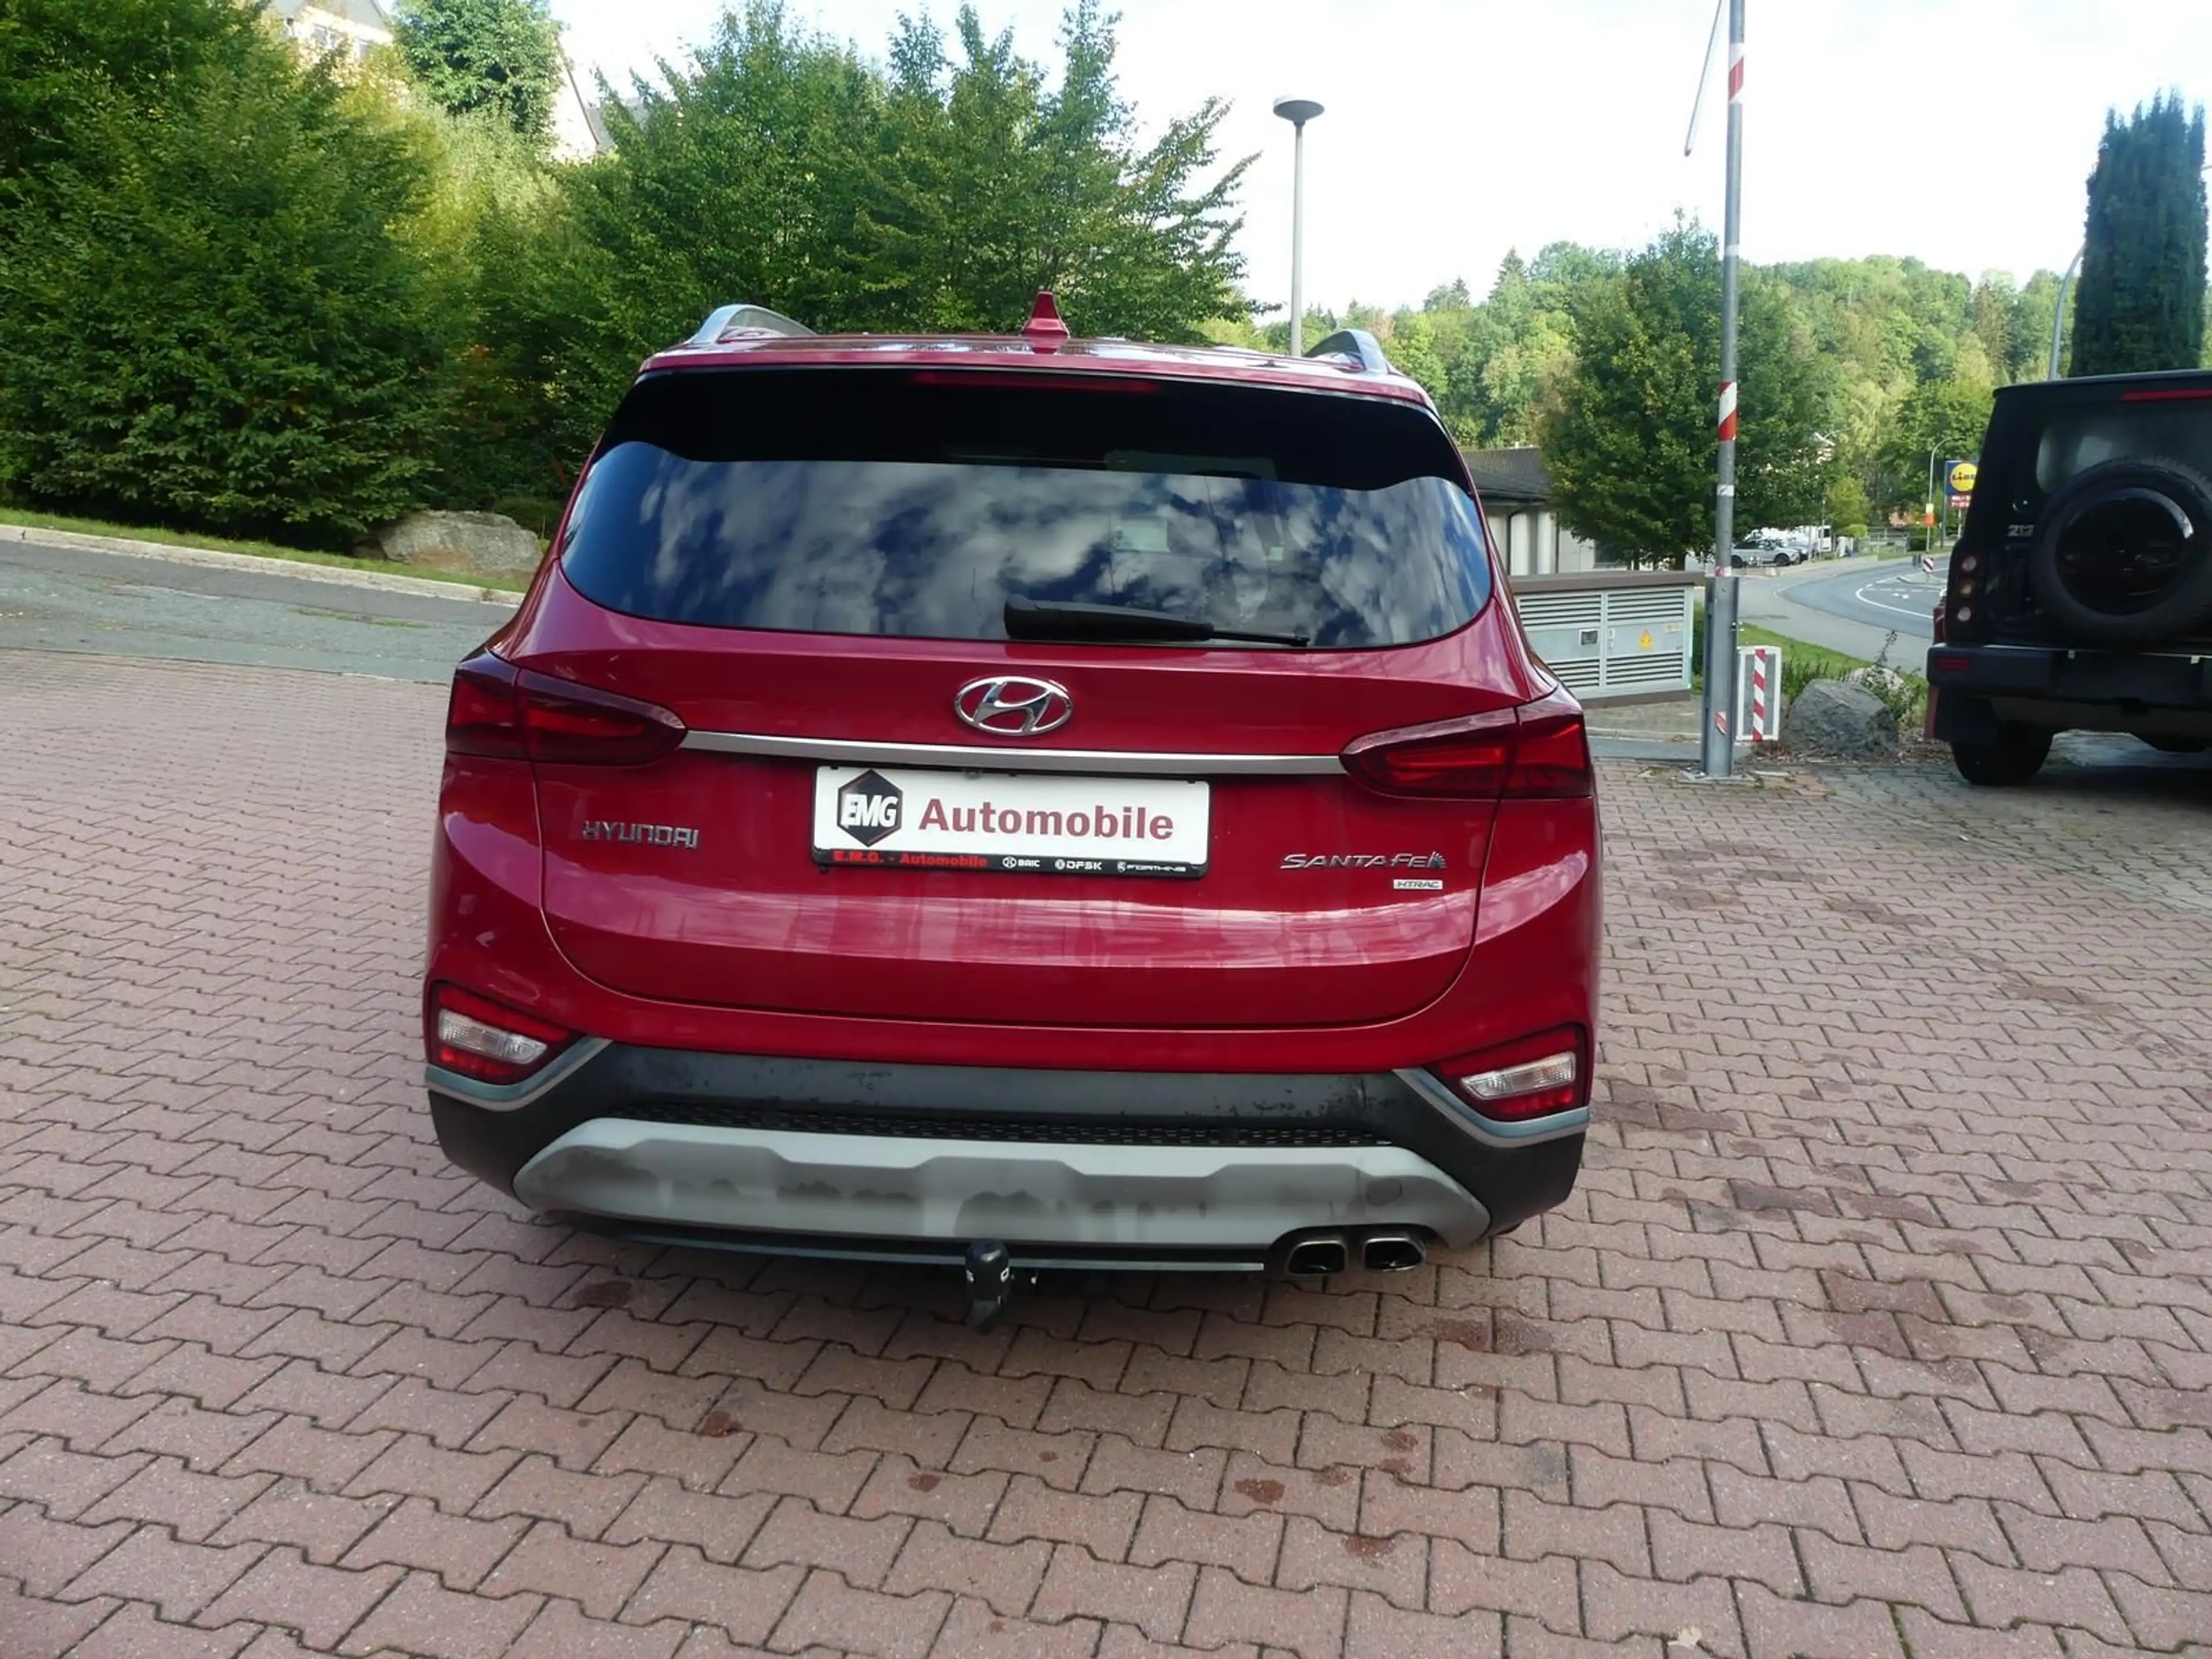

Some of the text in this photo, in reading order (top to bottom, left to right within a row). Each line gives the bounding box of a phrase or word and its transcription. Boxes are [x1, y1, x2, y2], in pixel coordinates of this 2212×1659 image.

[840, 793, 897, 828] EMG
[919, 798, 1173, 840] Automobile
[582, 820, 699, 849] HYUNDAI
[900, 853, 988, 868] Automobile
[1018, 859, 1040, 868] BAIC
[1067, 861, 1103, 871] DFSK
